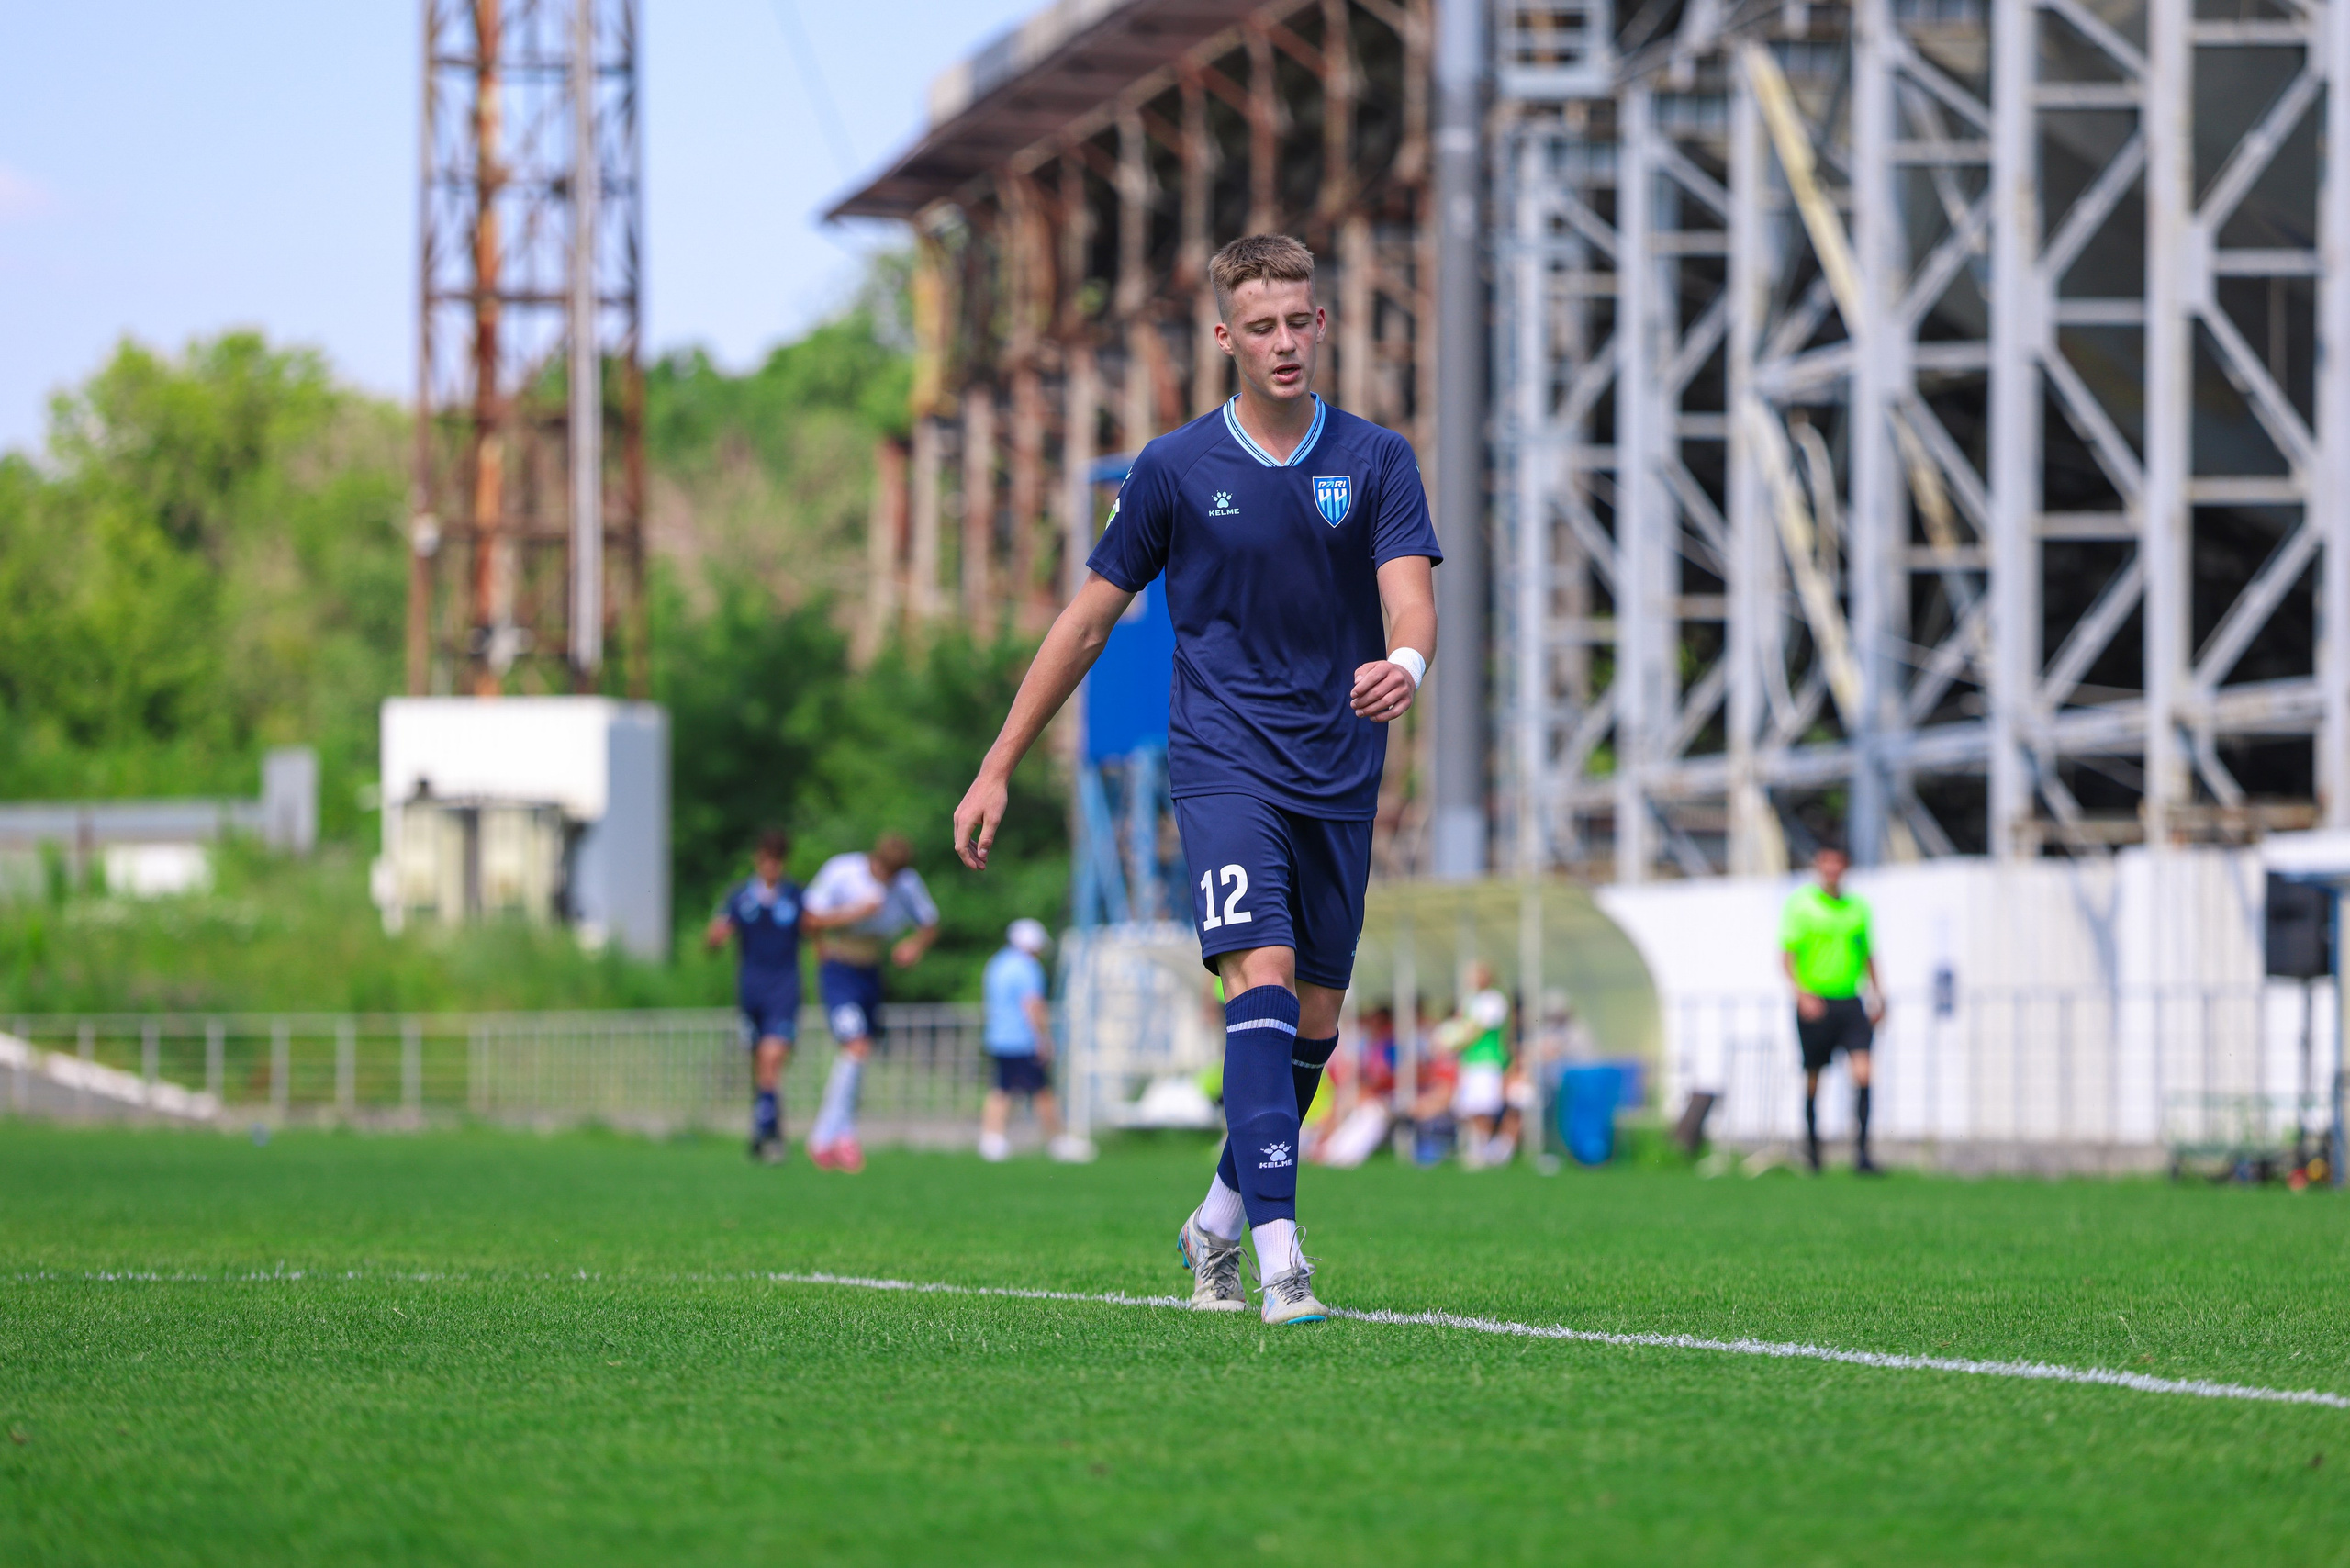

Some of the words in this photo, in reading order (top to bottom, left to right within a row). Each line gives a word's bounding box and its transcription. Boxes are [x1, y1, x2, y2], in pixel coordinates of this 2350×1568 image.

[1208, 508, 1240, 517] KELME
[1200, 864, 1252, 932] 12
[1259, 1159, 1292, 1169] KELME
